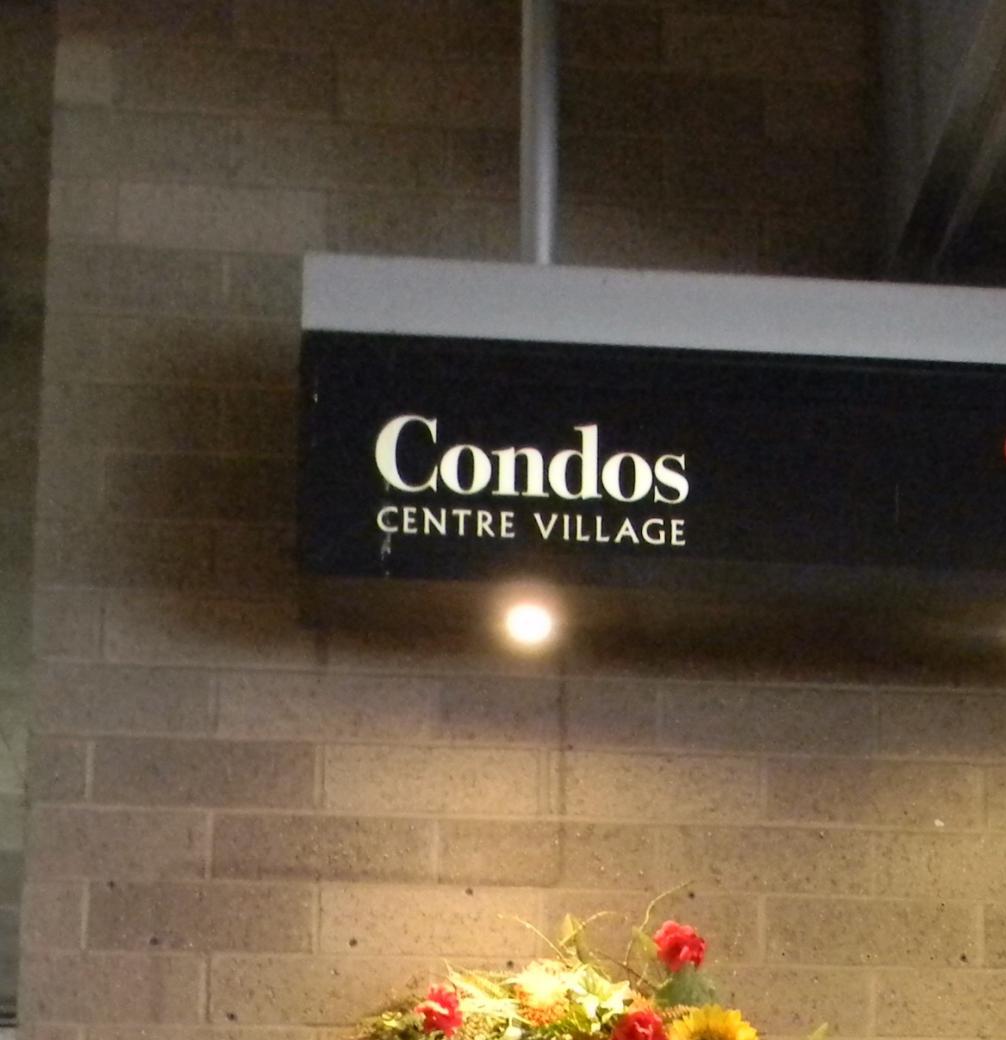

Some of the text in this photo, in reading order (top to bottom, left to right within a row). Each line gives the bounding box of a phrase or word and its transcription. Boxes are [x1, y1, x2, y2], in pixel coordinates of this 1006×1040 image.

[375, 414, 690, 504] Condos
[376, 505, 687, 546] CENTRE VILLAGE
